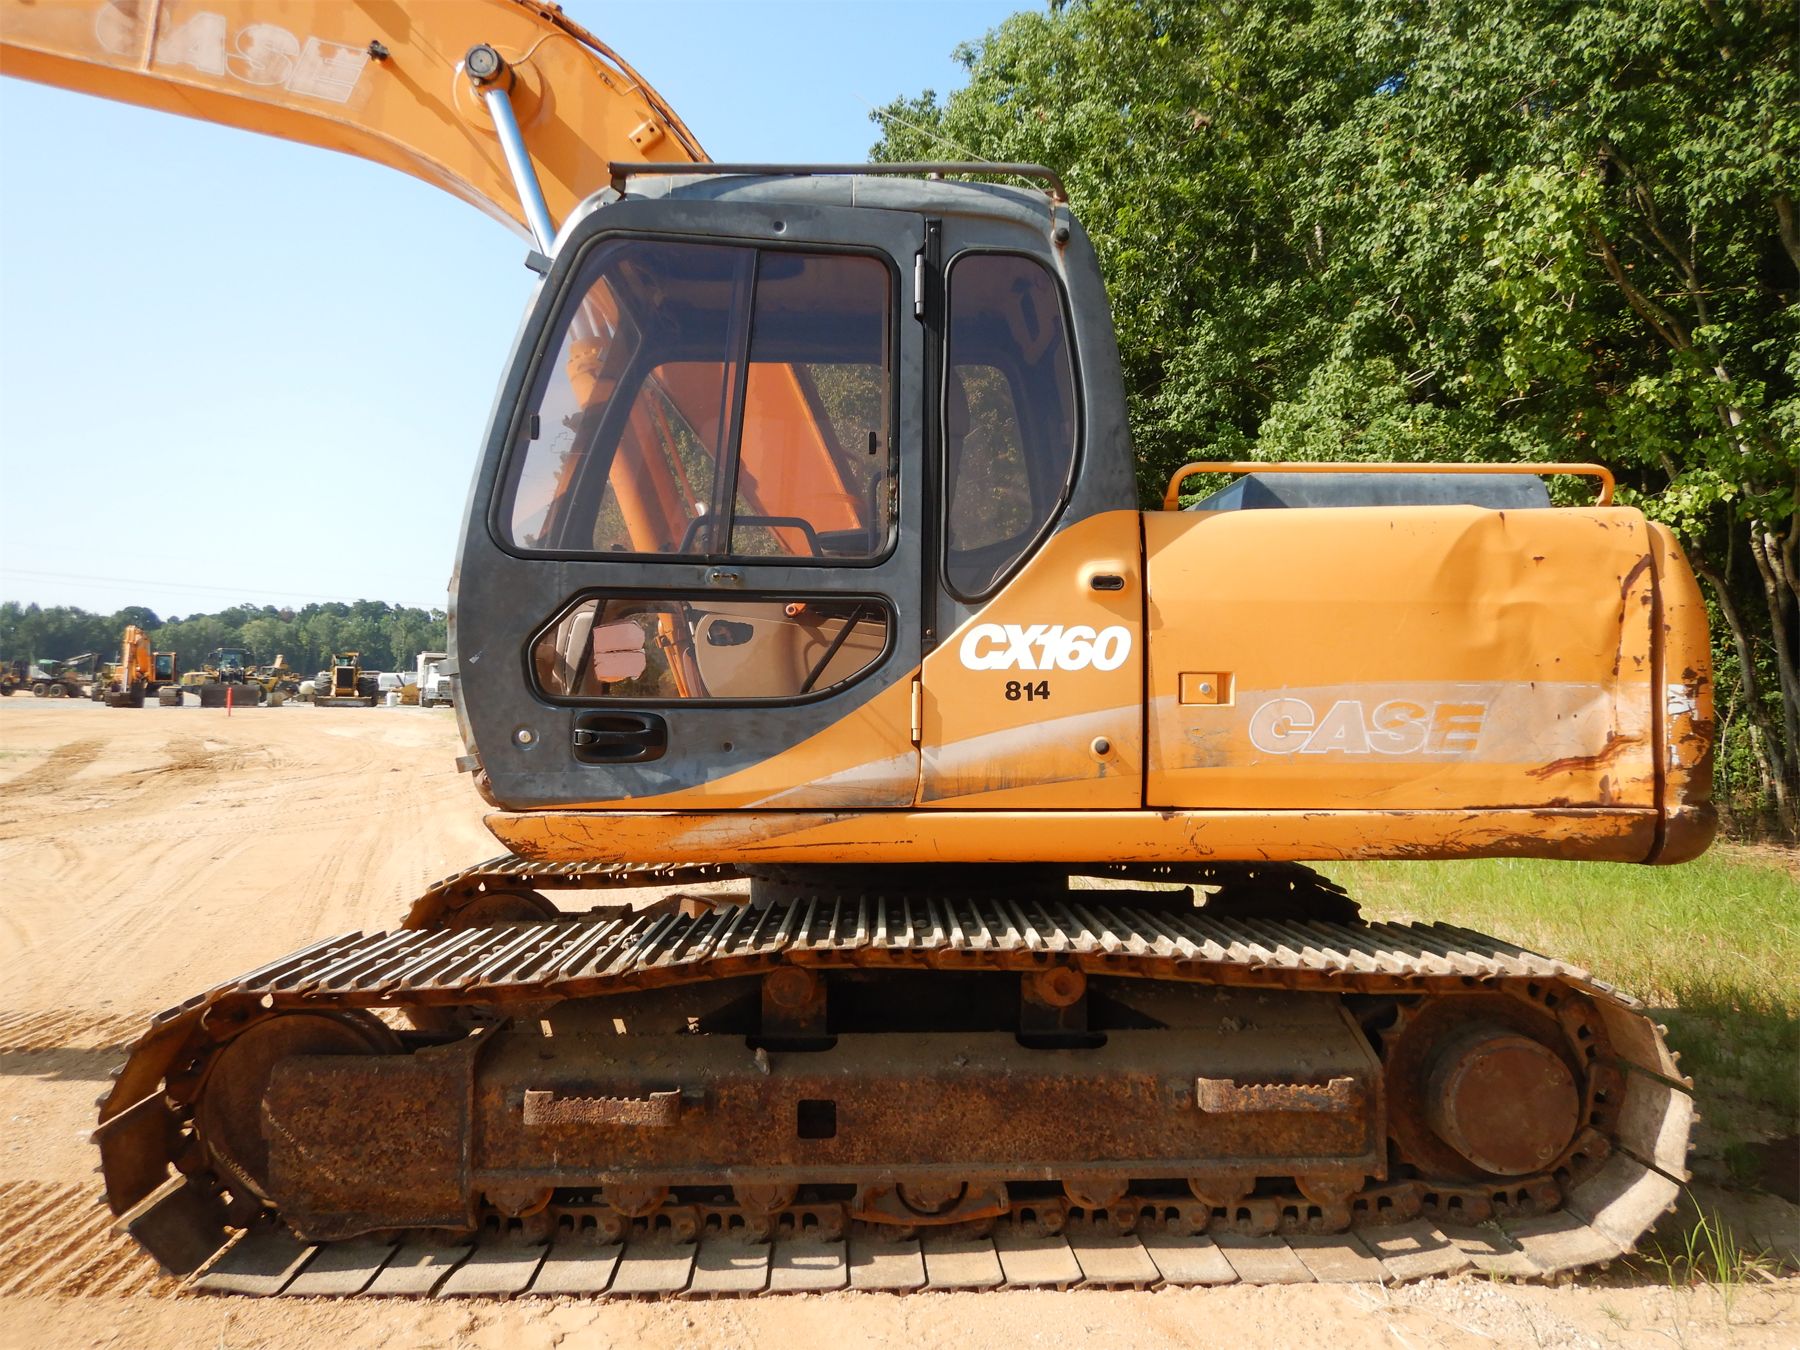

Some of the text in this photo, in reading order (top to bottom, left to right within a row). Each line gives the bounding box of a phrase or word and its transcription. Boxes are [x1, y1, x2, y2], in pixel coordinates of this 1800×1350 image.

[959, 623, 1132, 671] CX160
[1005, 681, 1050, 701] 814
[1249, 698, 1489, 755] CASE
